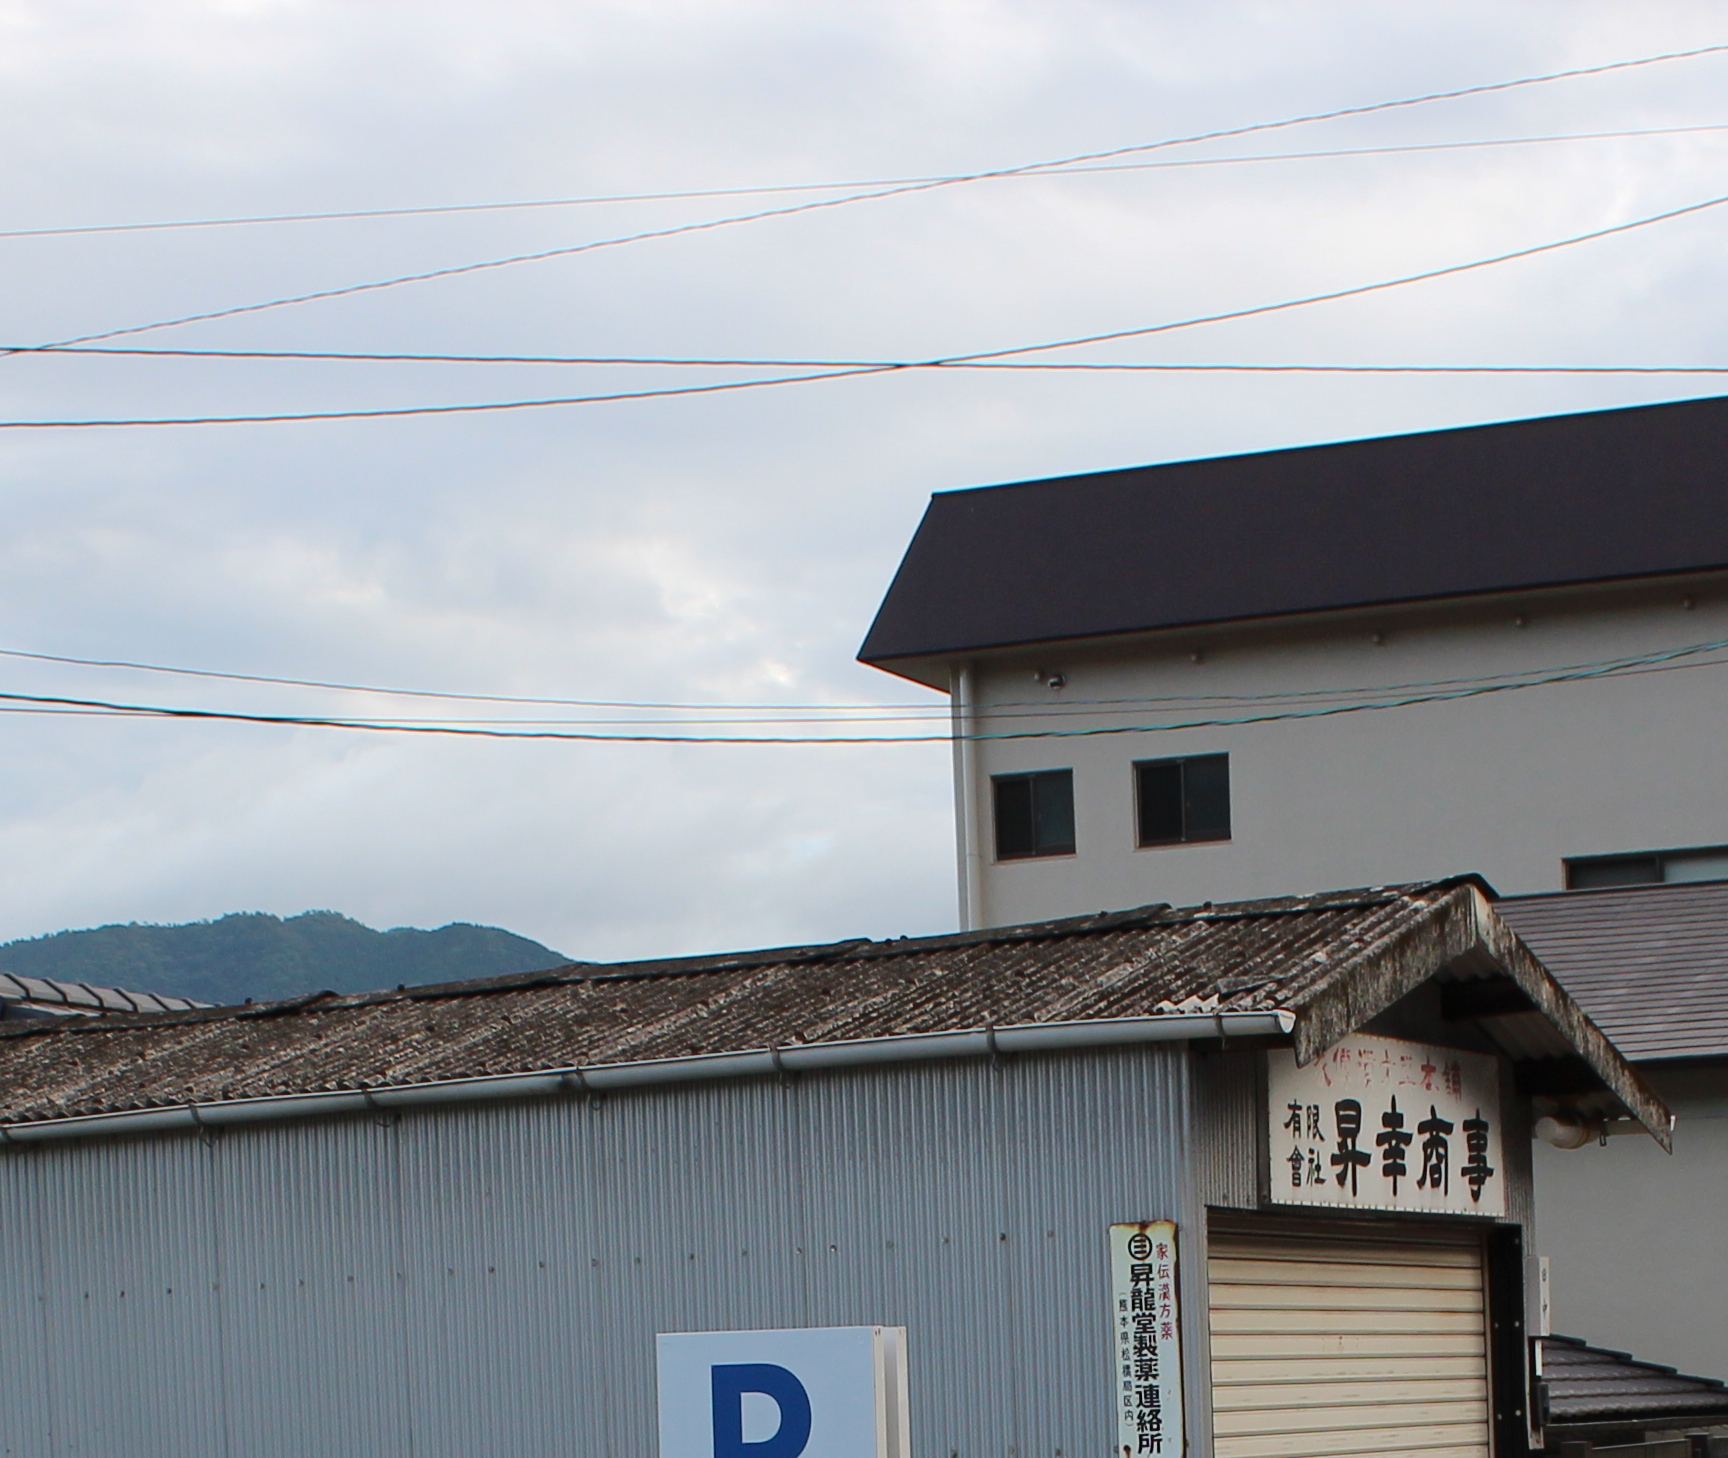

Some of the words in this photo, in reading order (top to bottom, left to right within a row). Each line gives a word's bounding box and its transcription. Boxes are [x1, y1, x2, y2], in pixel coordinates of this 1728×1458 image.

[1283, 1098, 1326, 1142] 有限
[1330, 1093, 1495, 1203] 昇幸商事
